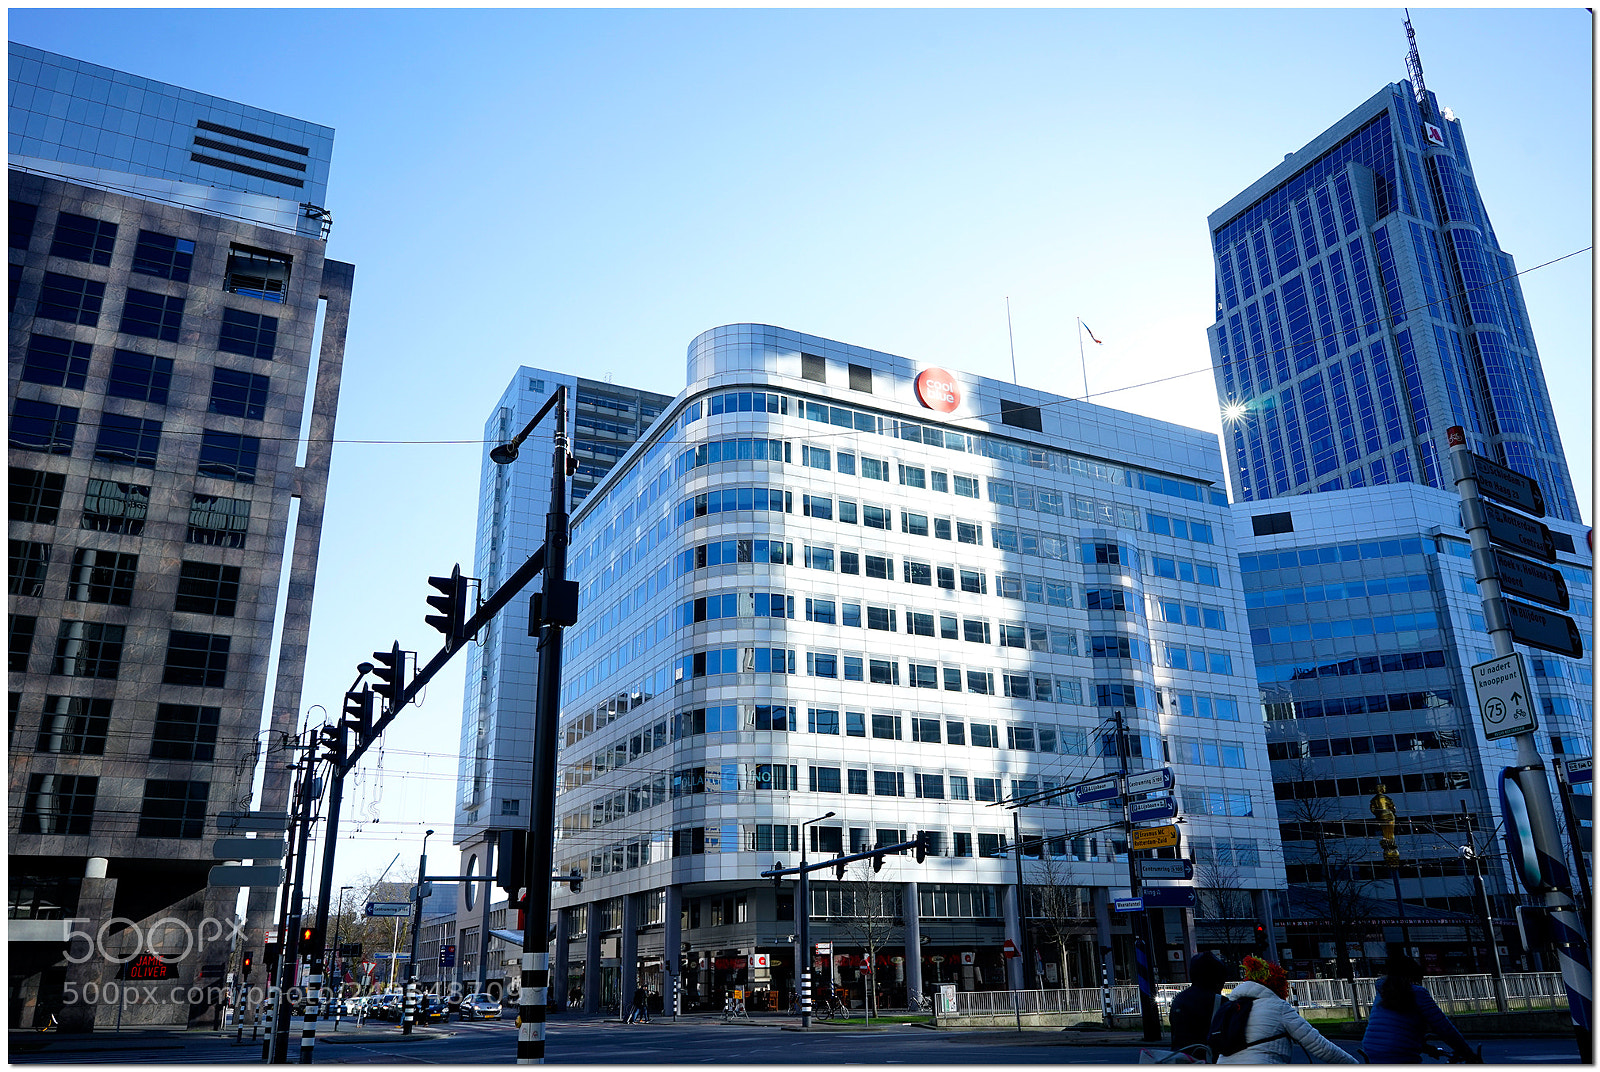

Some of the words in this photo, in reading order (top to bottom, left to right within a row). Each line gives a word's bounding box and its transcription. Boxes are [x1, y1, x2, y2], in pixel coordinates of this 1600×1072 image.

[926, 379, 954, 393] cool
[927, 387, 954, 403] blue
[1489, 465, 1521, 486] Schiedam
[1479, 475, 1493, 489] Den
[1494, 481, 1511, 498] Haag
[1502, 513, 1537, 534] Rotterdam
[1501, 572, 1523, 588] Noord
[1523, 563, 1547, 581] Holland
[1519, 608, 1547, 627] Blijdorp
[1480, 668, 1487, 677] U
[1488, 661, 1511, 674] nadert
[1479, 671, 1517, 688] knooppunt
[1488, 703, 1503, 717] 75
[1135, 837, 1168, 847] Rotterdam-Zuid
[1143, 865, 1170, 873] Centrumring
[136, 955, 165, 967] JAMIE
[131, 966, 167, 978] OLIVER
